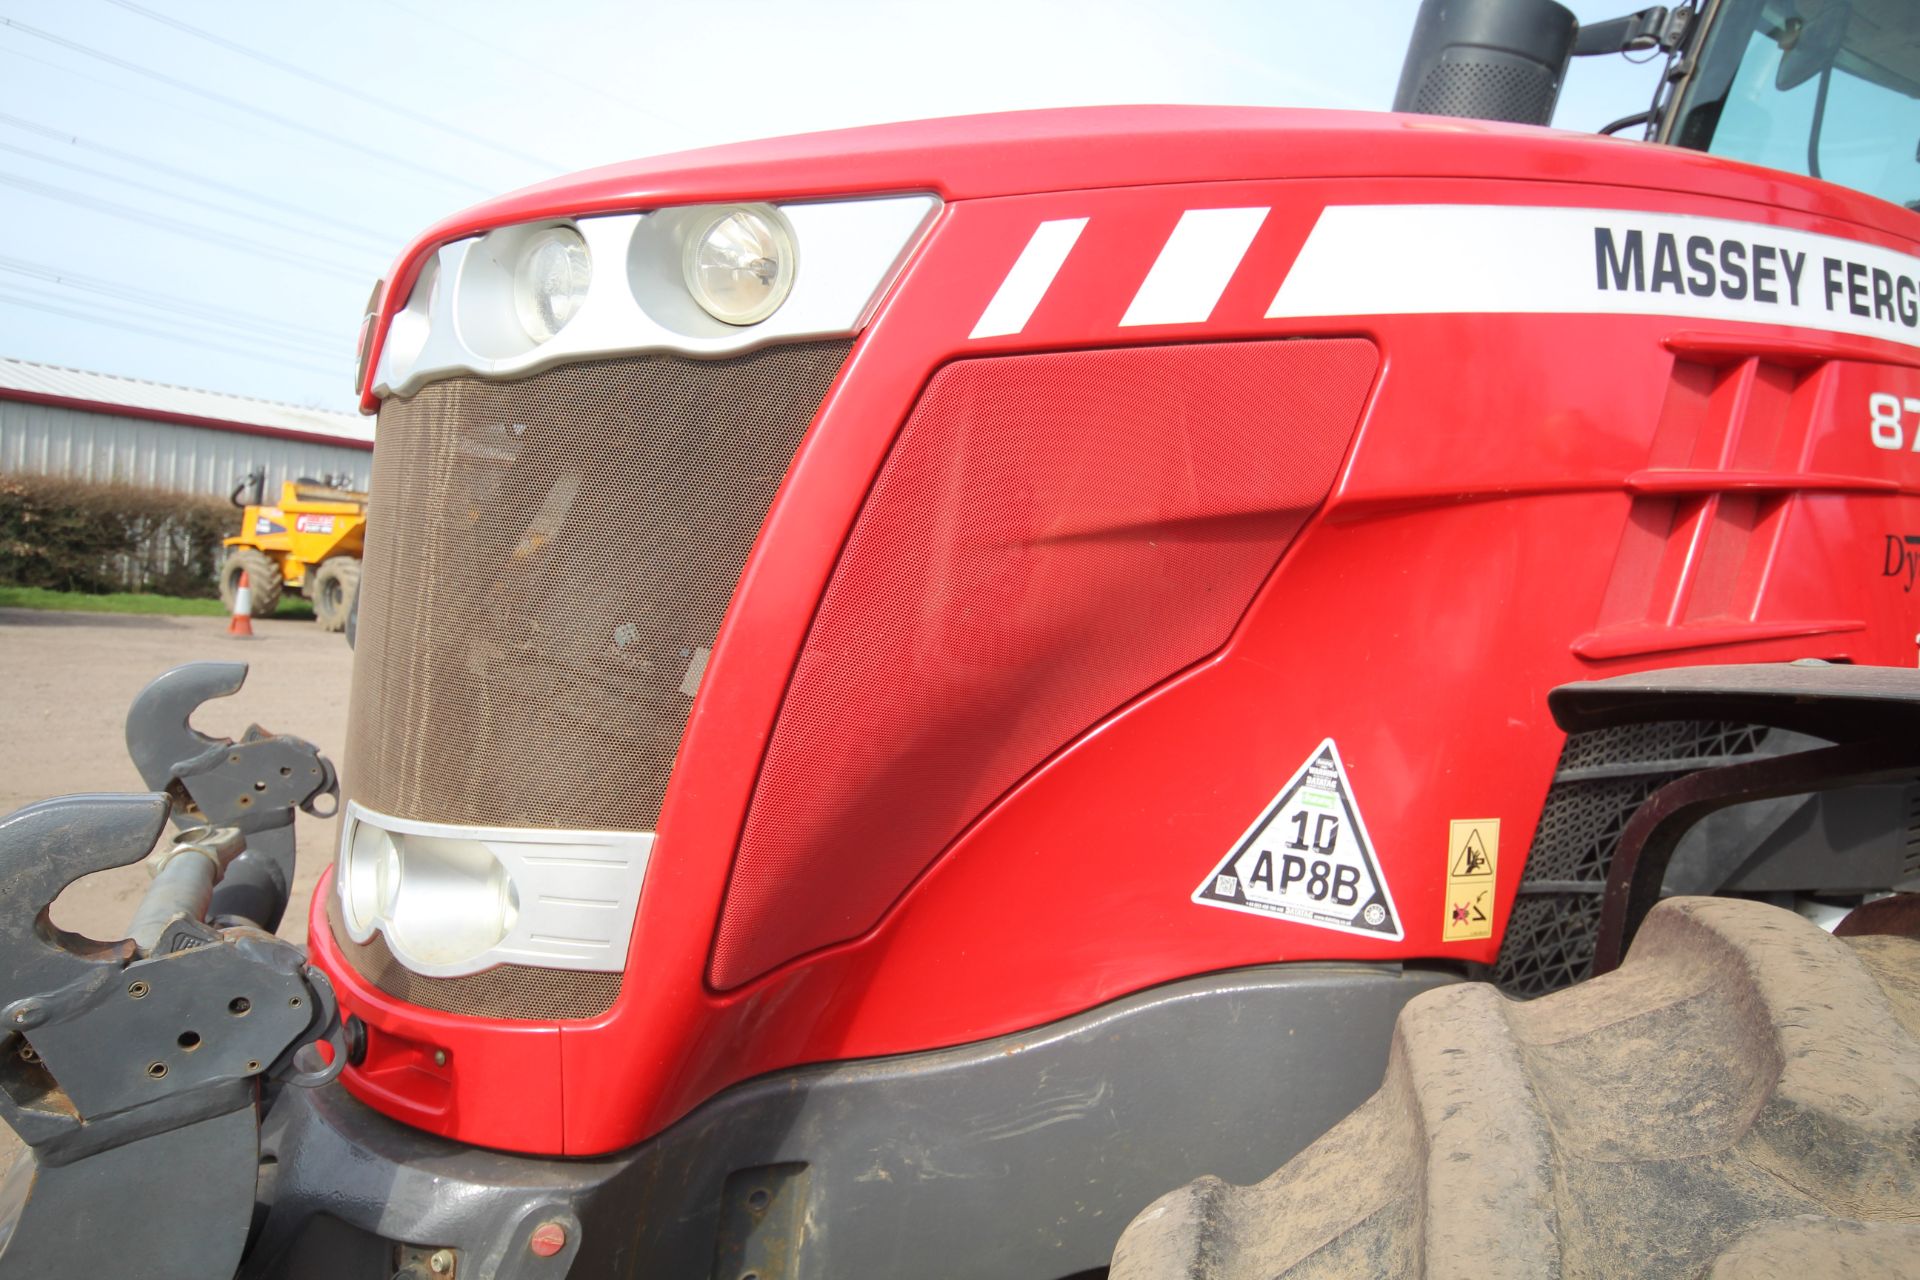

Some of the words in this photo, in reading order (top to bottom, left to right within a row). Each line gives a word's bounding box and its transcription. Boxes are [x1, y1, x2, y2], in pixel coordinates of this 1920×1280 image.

[1594, 227, 1806, 306] MASSEY
[1823, 256, 1920, 328] FERG
[1249, 849, 1361, 907] AP8B
